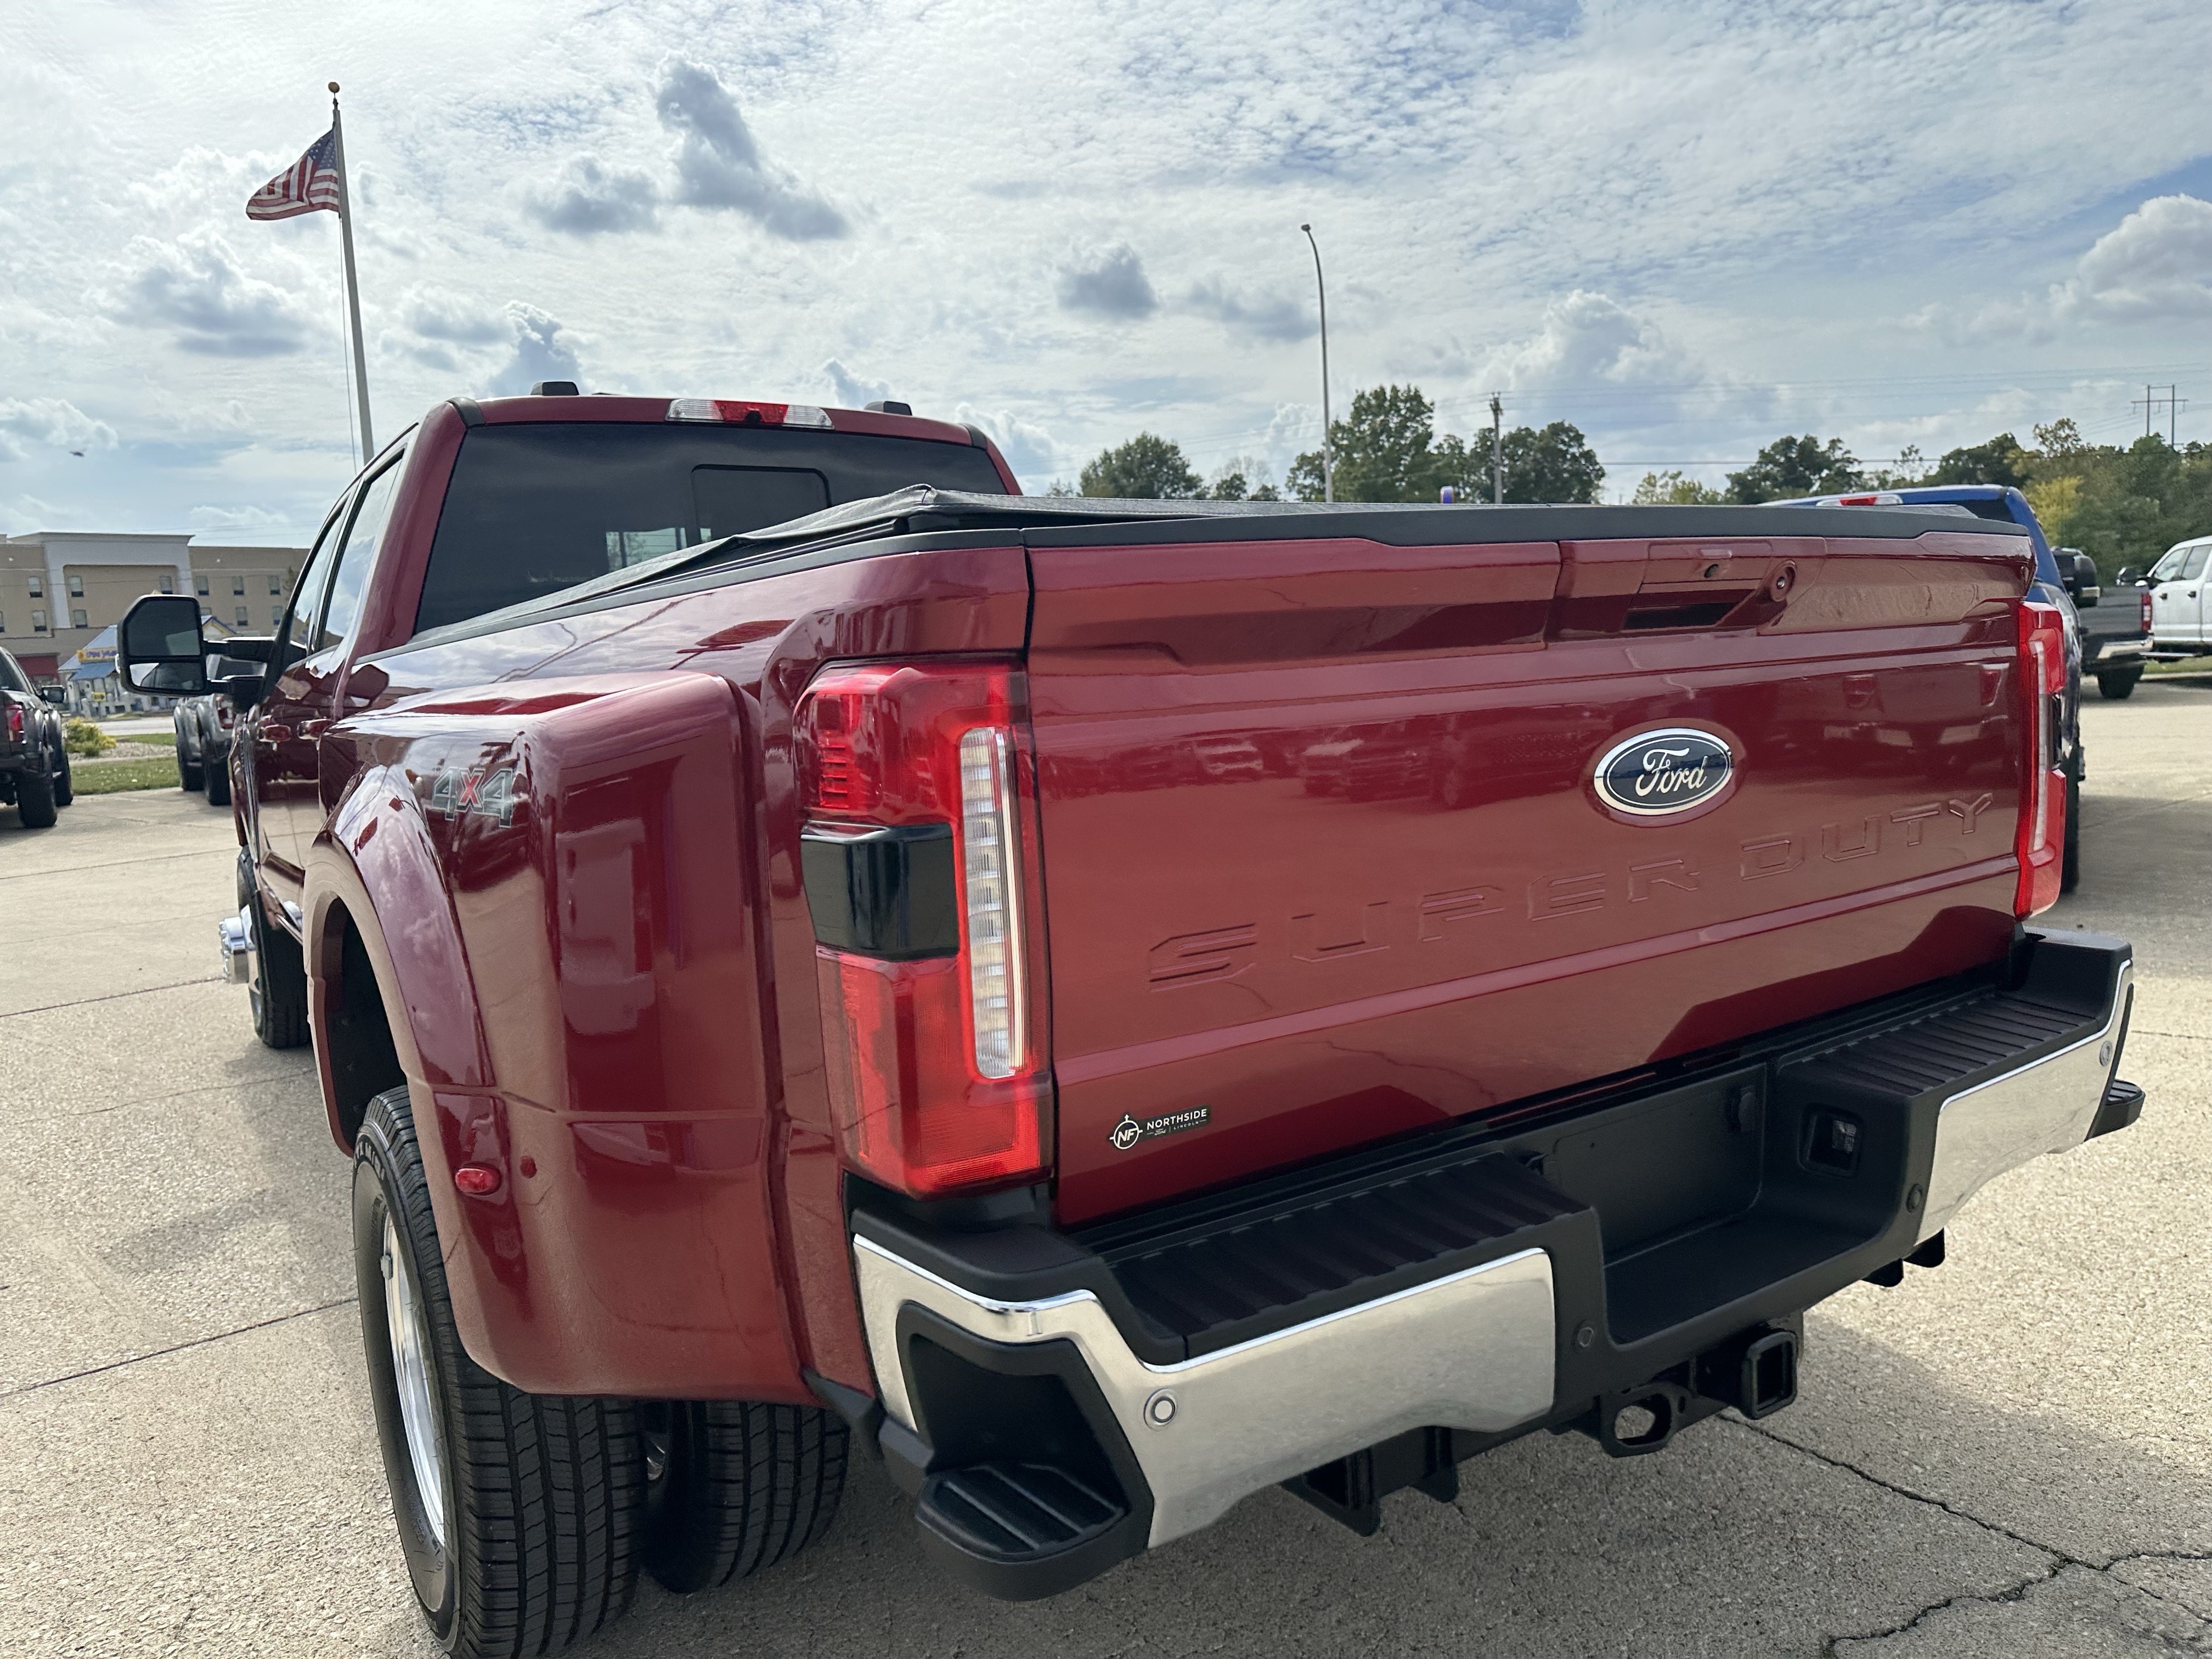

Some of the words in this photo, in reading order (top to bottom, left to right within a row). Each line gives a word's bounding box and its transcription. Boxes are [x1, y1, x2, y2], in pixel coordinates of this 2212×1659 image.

[1635, 748, 1708, 797] Ford
[1148, 856, 1701, 992] SUPER
[1740, 792, 1994, 881] DUTY
[1147, 1108, 1207, 1131] NORTHSIDE
[1173, 1121, 1199, 1130] LINCOLN
[1117, 1128, 1138, 1147] NF
